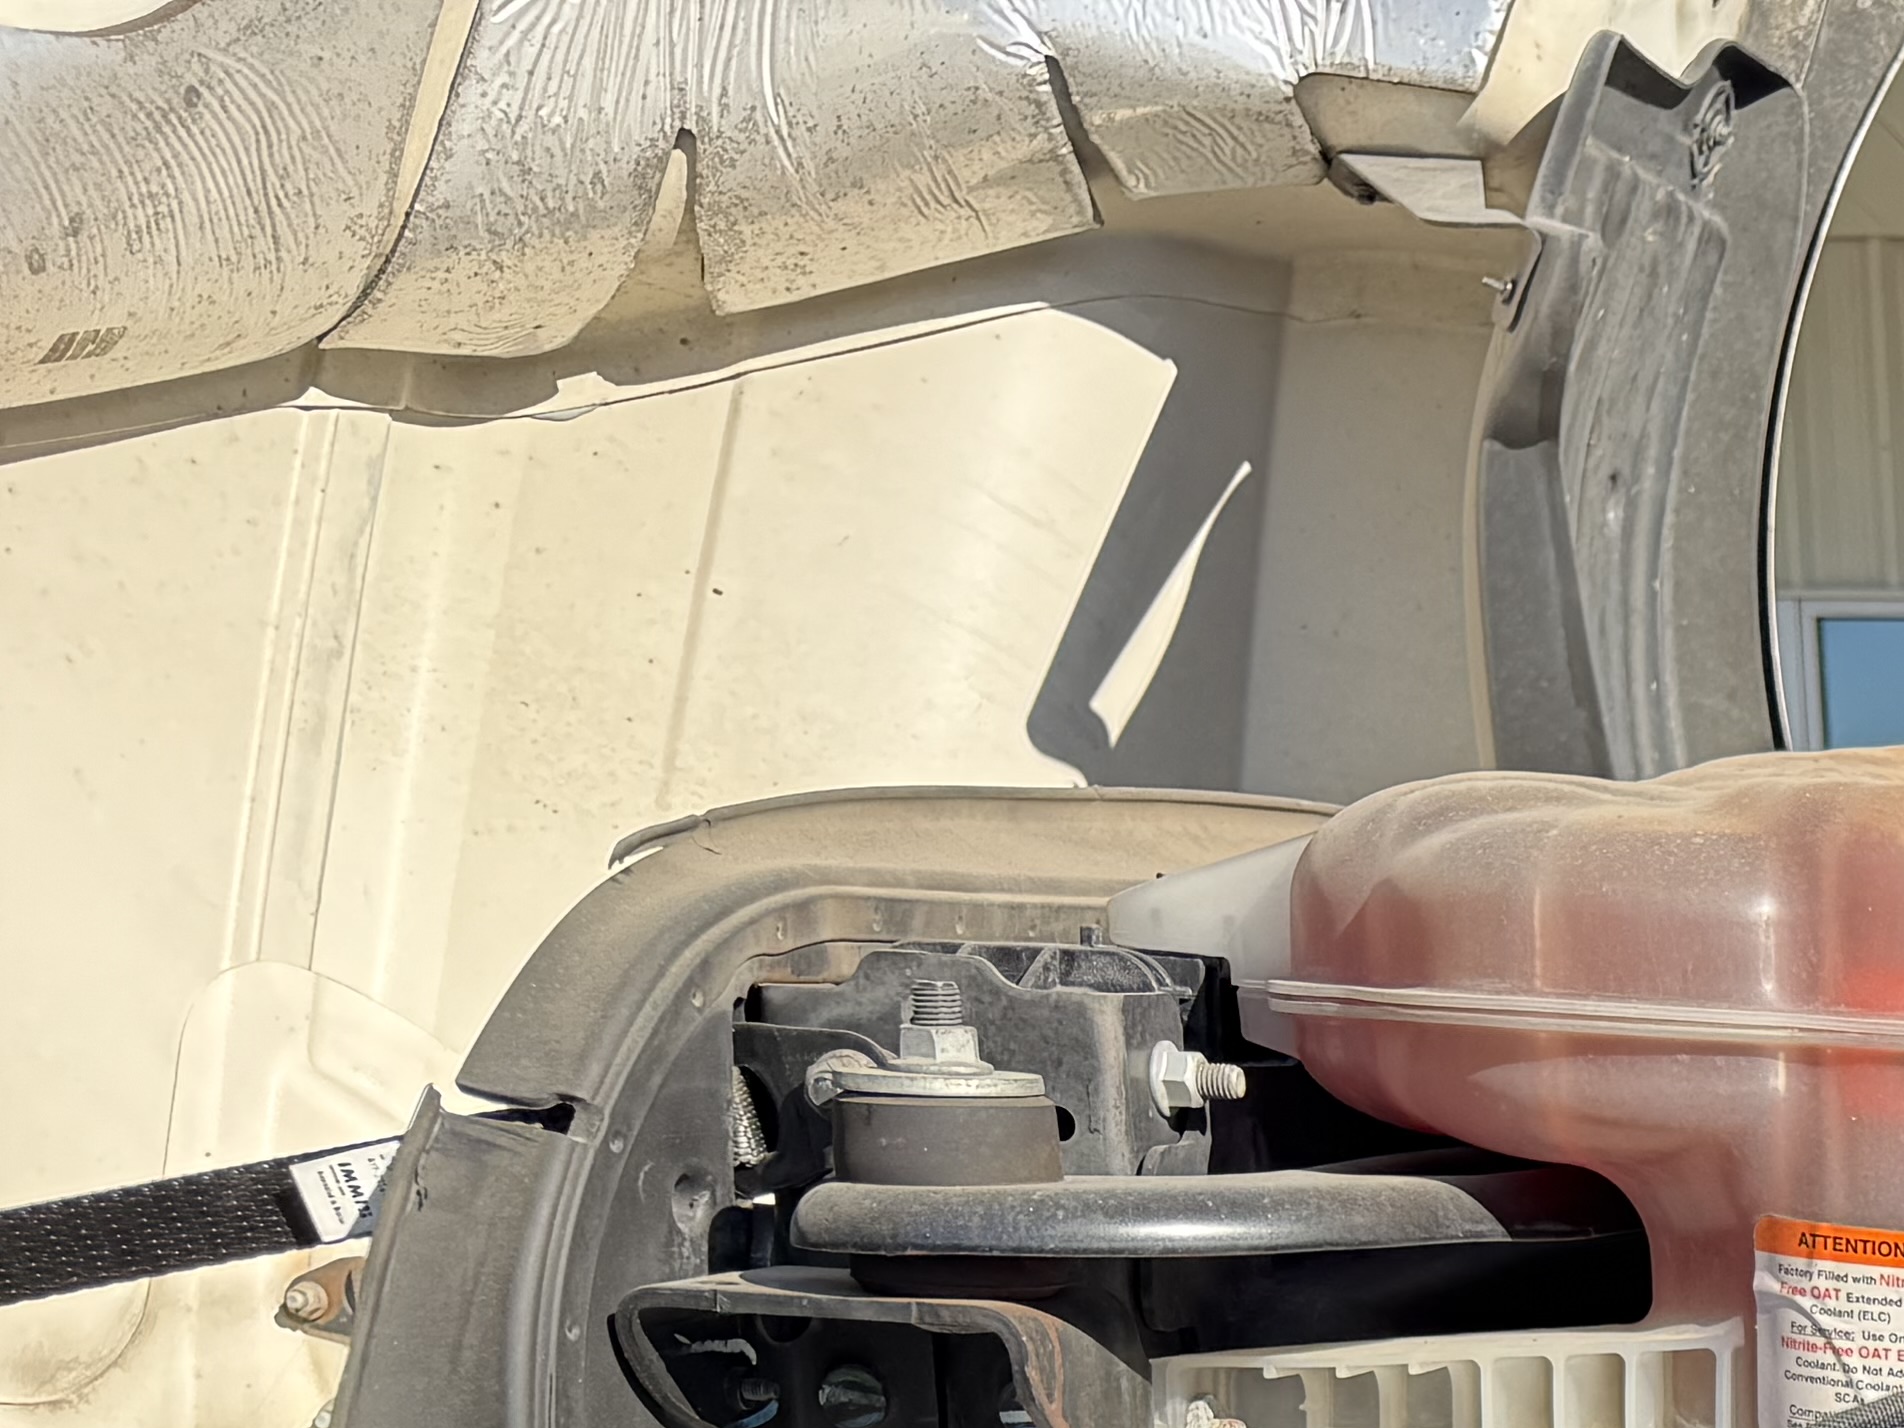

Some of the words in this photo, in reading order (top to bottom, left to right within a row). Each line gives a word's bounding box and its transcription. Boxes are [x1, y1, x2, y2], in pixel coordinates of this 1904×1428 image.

[1778, 1264, 1814, 1281] Factory
[1817, 1270, 1848, 1283] Filled
[1852, 1272, 1877, 1285] with
[1780, 1283, 1807, 1297] Free
[1811, 1286, 1841, 1301] OAT
[1847, 1293, 1902, 1308] Extended
[1810, 1304, 1853, 1319] Coolant
[1858, 1309, 1891, 1324] (ELC)
[1791, 1322, 1807, 1334] For
[1862, 1331, 1884, 1343] Use
[1781, 1336, 1853, 1357] Nitrite-Free
[1859, 1347, 1892, 1361] OAT
[1785, 1370, 1853, 1388] Conventional
[1843, 1363, 1858, 1375] Do
[1862, 1365, 1884, 1377] Not
